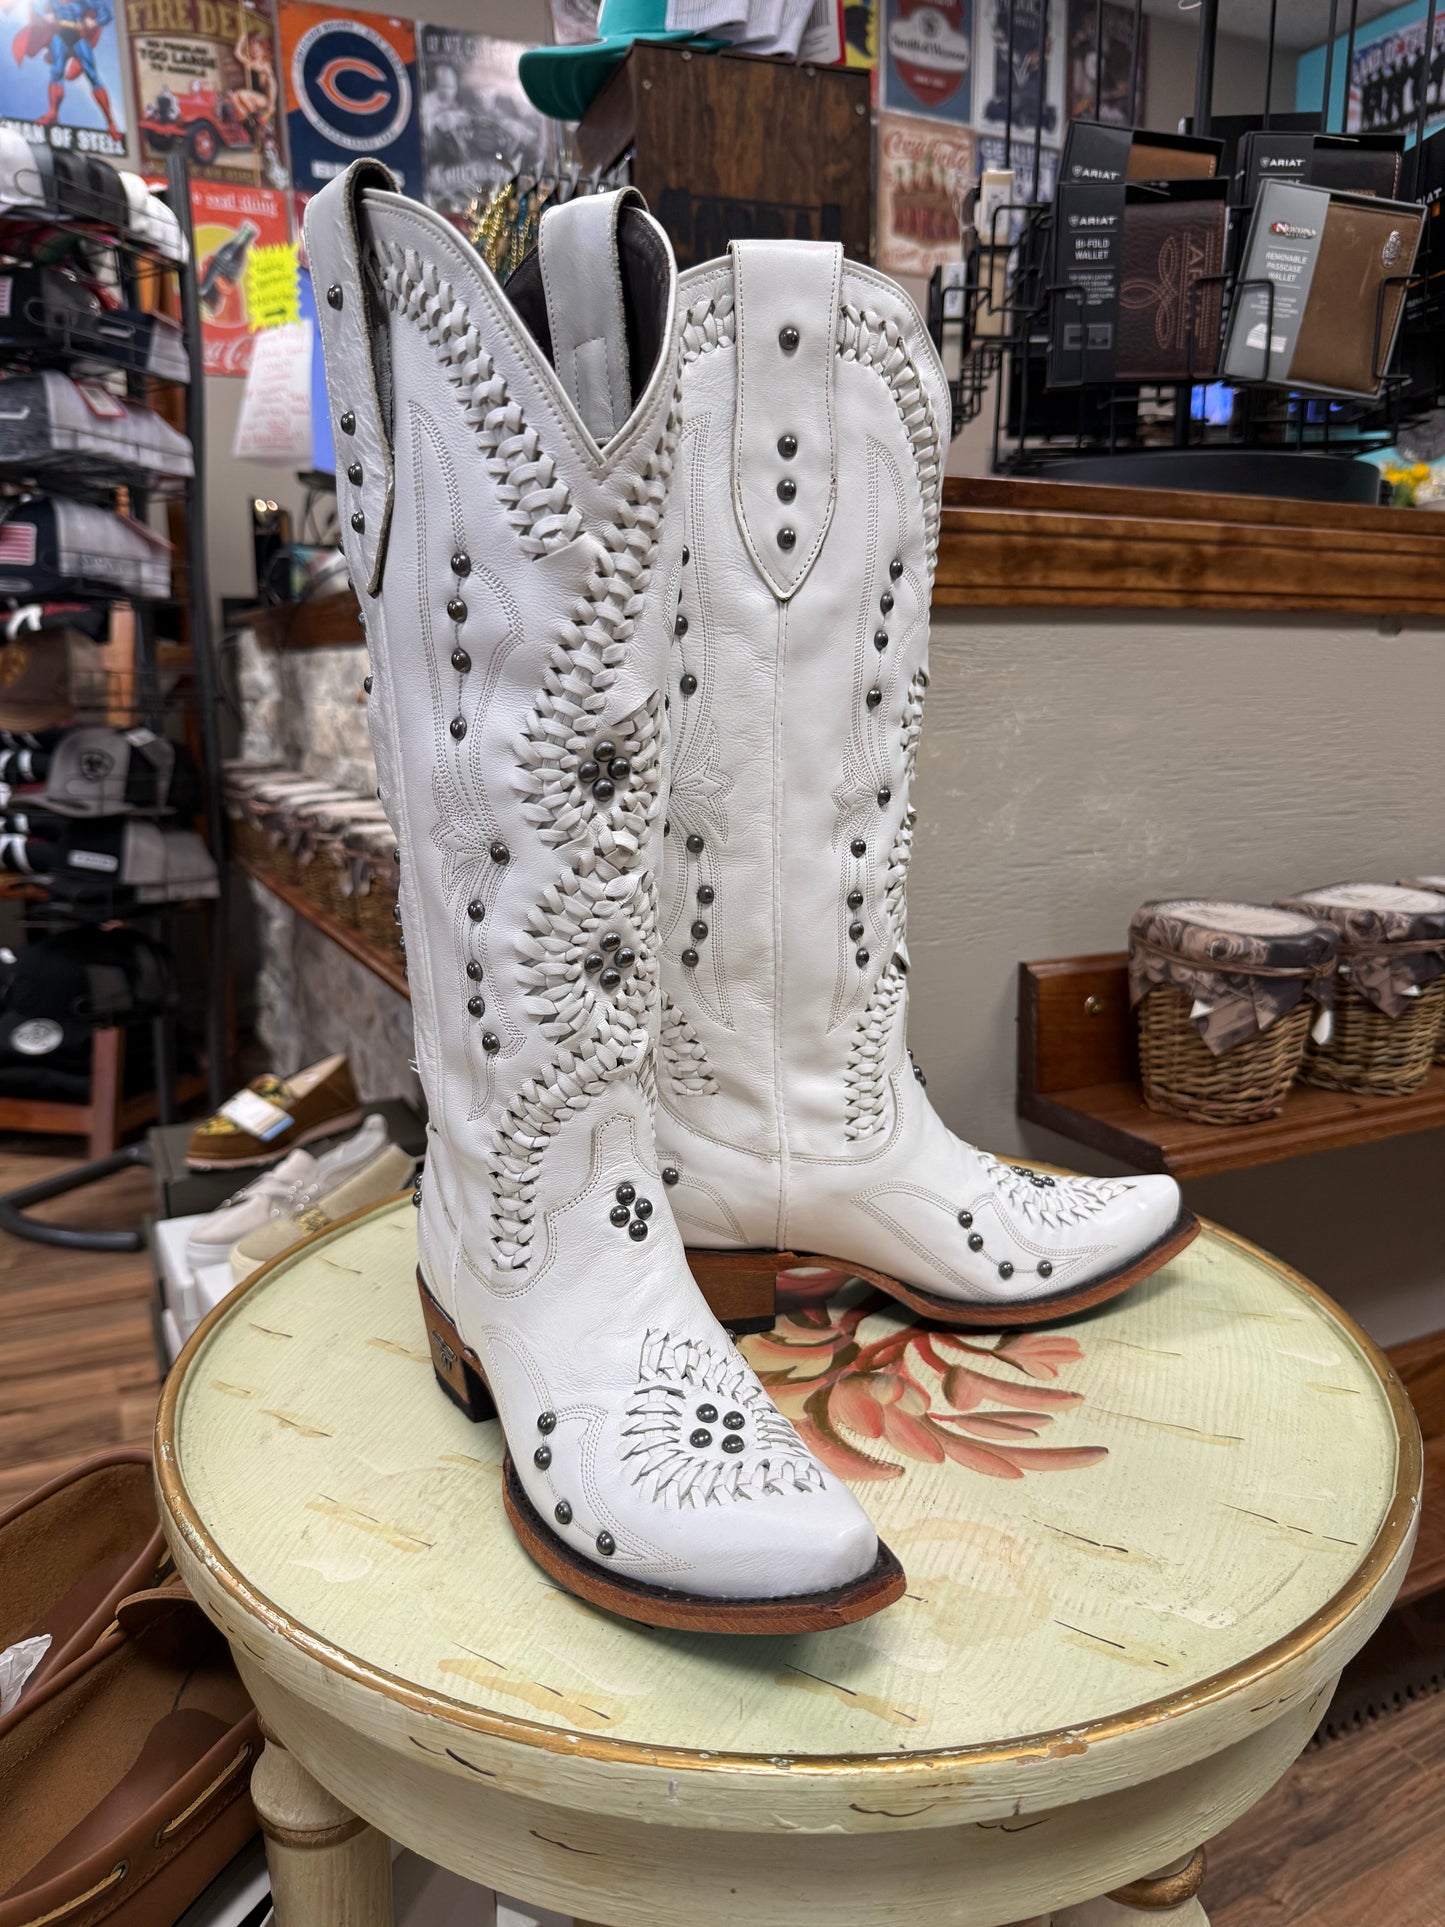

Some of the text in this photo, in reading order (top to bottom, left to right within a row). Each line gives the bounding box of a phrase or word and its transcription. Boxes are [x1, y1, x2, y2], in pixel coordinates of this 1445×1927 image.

[127, 0, 194, 32] FIRE
[50, 126, 73, 149] OF
[1269, 158, 1306, 168] ARIAT
[1082, 168, 1121, 181] ARIAT
[1080, 215, 1118, 226] ARIAT
[1075, 238, 1111, 250] BI-FOLD
[1075, 250, 1110, 260] WALLET
[1265, 251, 1308, 265] REMOVABLE
[1268, 271, 1297, 282] WALLET
